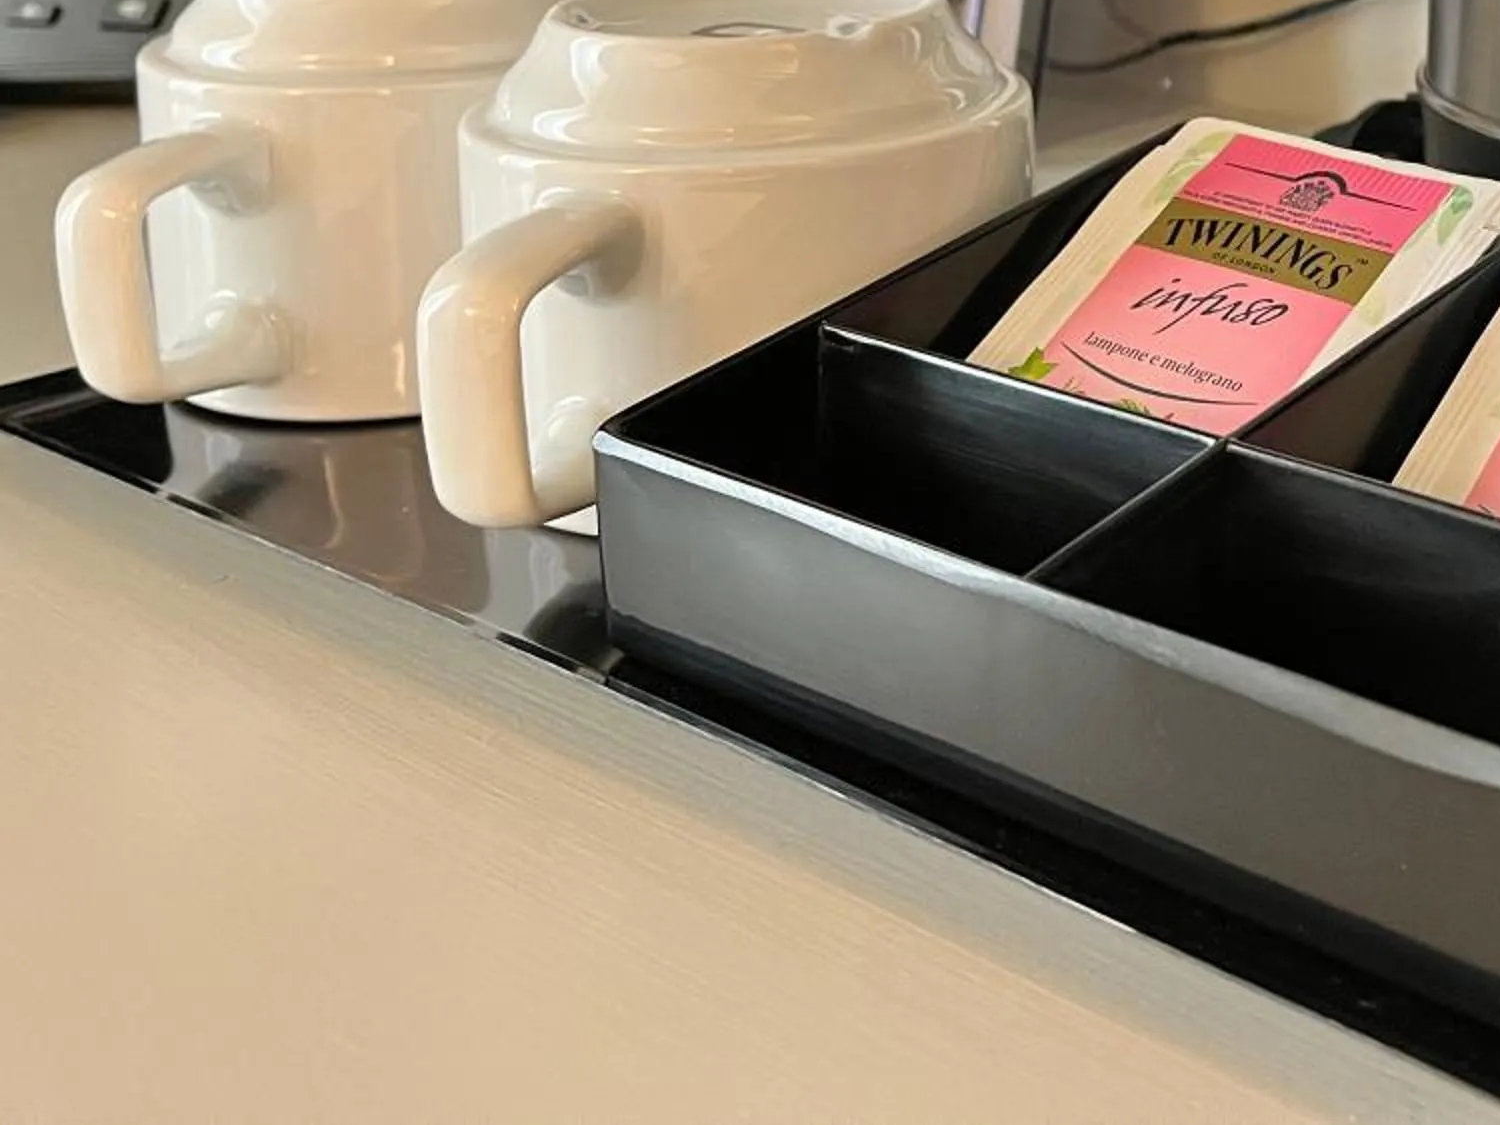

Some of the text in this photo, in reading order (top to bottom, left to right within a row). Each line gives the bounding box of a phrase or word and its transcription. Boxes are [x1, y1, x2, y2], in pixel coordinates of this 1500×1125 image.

[1165, 218, 1353, 290] TWININGS
[1130, 278, 1289, 335] infuso
[1083, 331, 1244, 392] lampone e melograno
